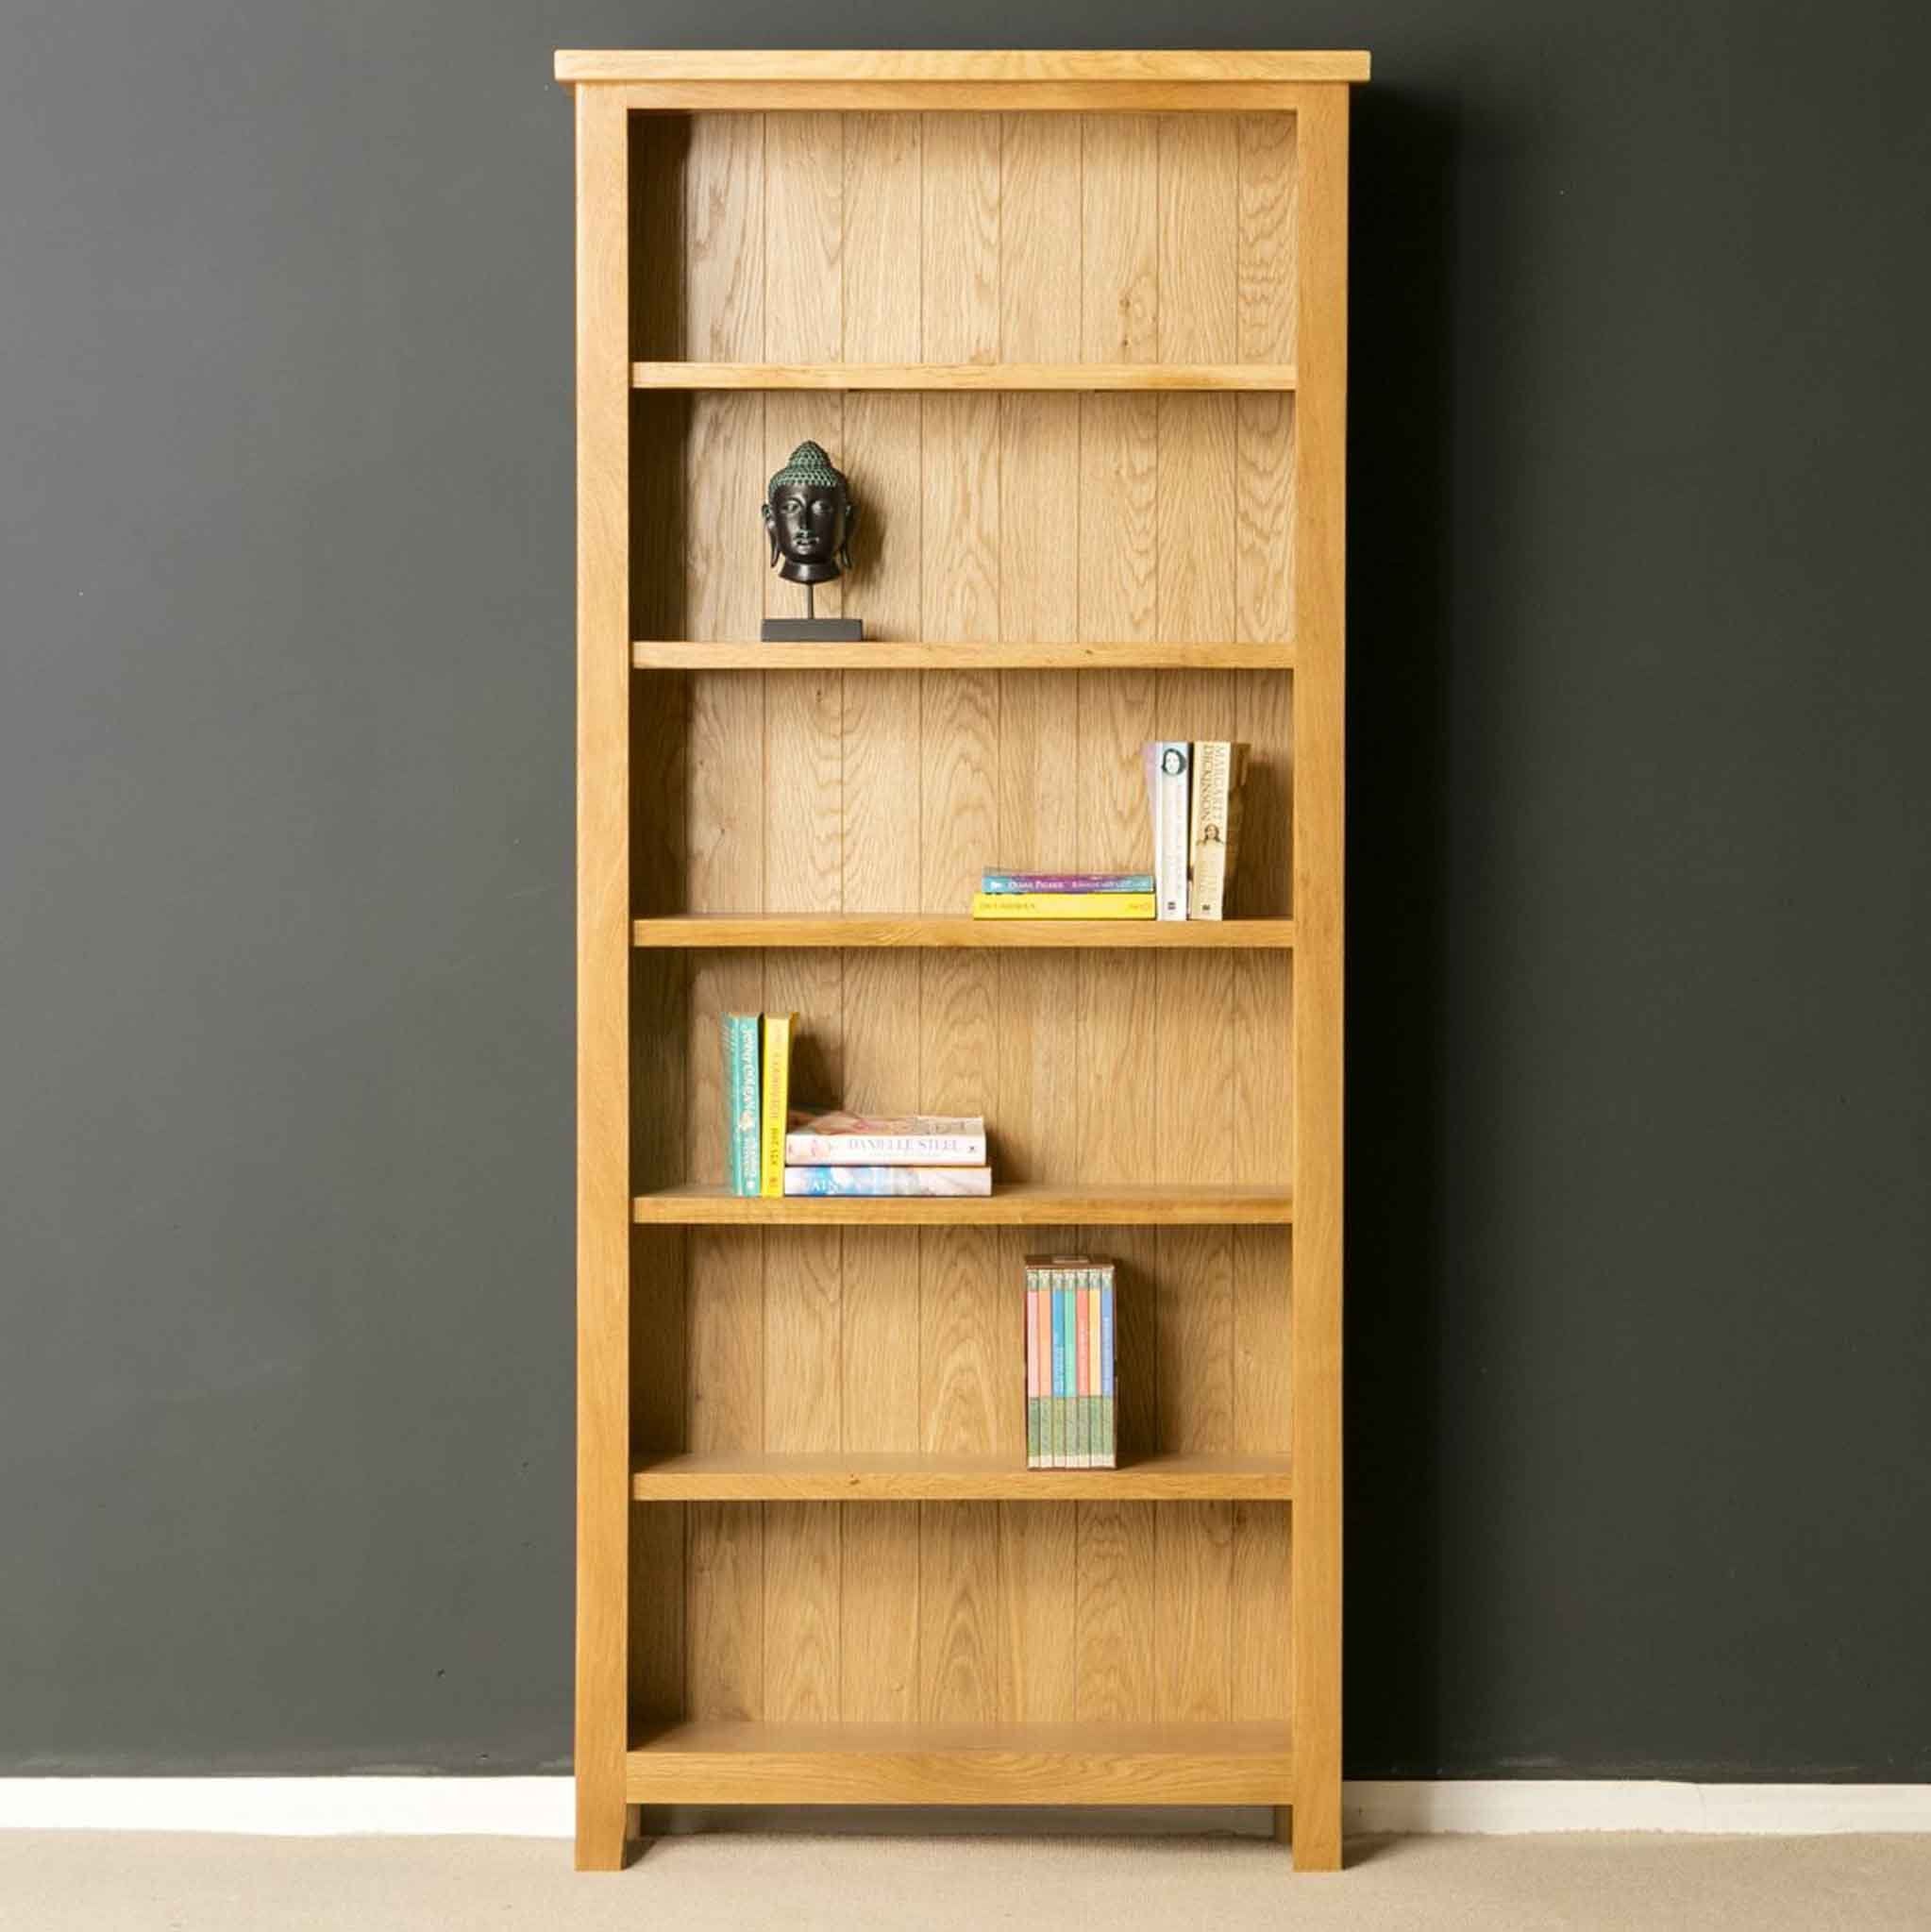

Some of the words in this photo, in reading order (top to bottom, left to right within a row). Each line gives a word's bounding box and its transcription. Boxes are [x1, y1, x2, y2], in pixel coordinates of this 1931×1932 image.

[1201, 744, 1214, 822] DICKINSON
[1212, 745, 1227, 820] MARGARET
[848, 1138, 914, 1151] DANIELLE
[917, 1138, 960, 1151] STEEL
